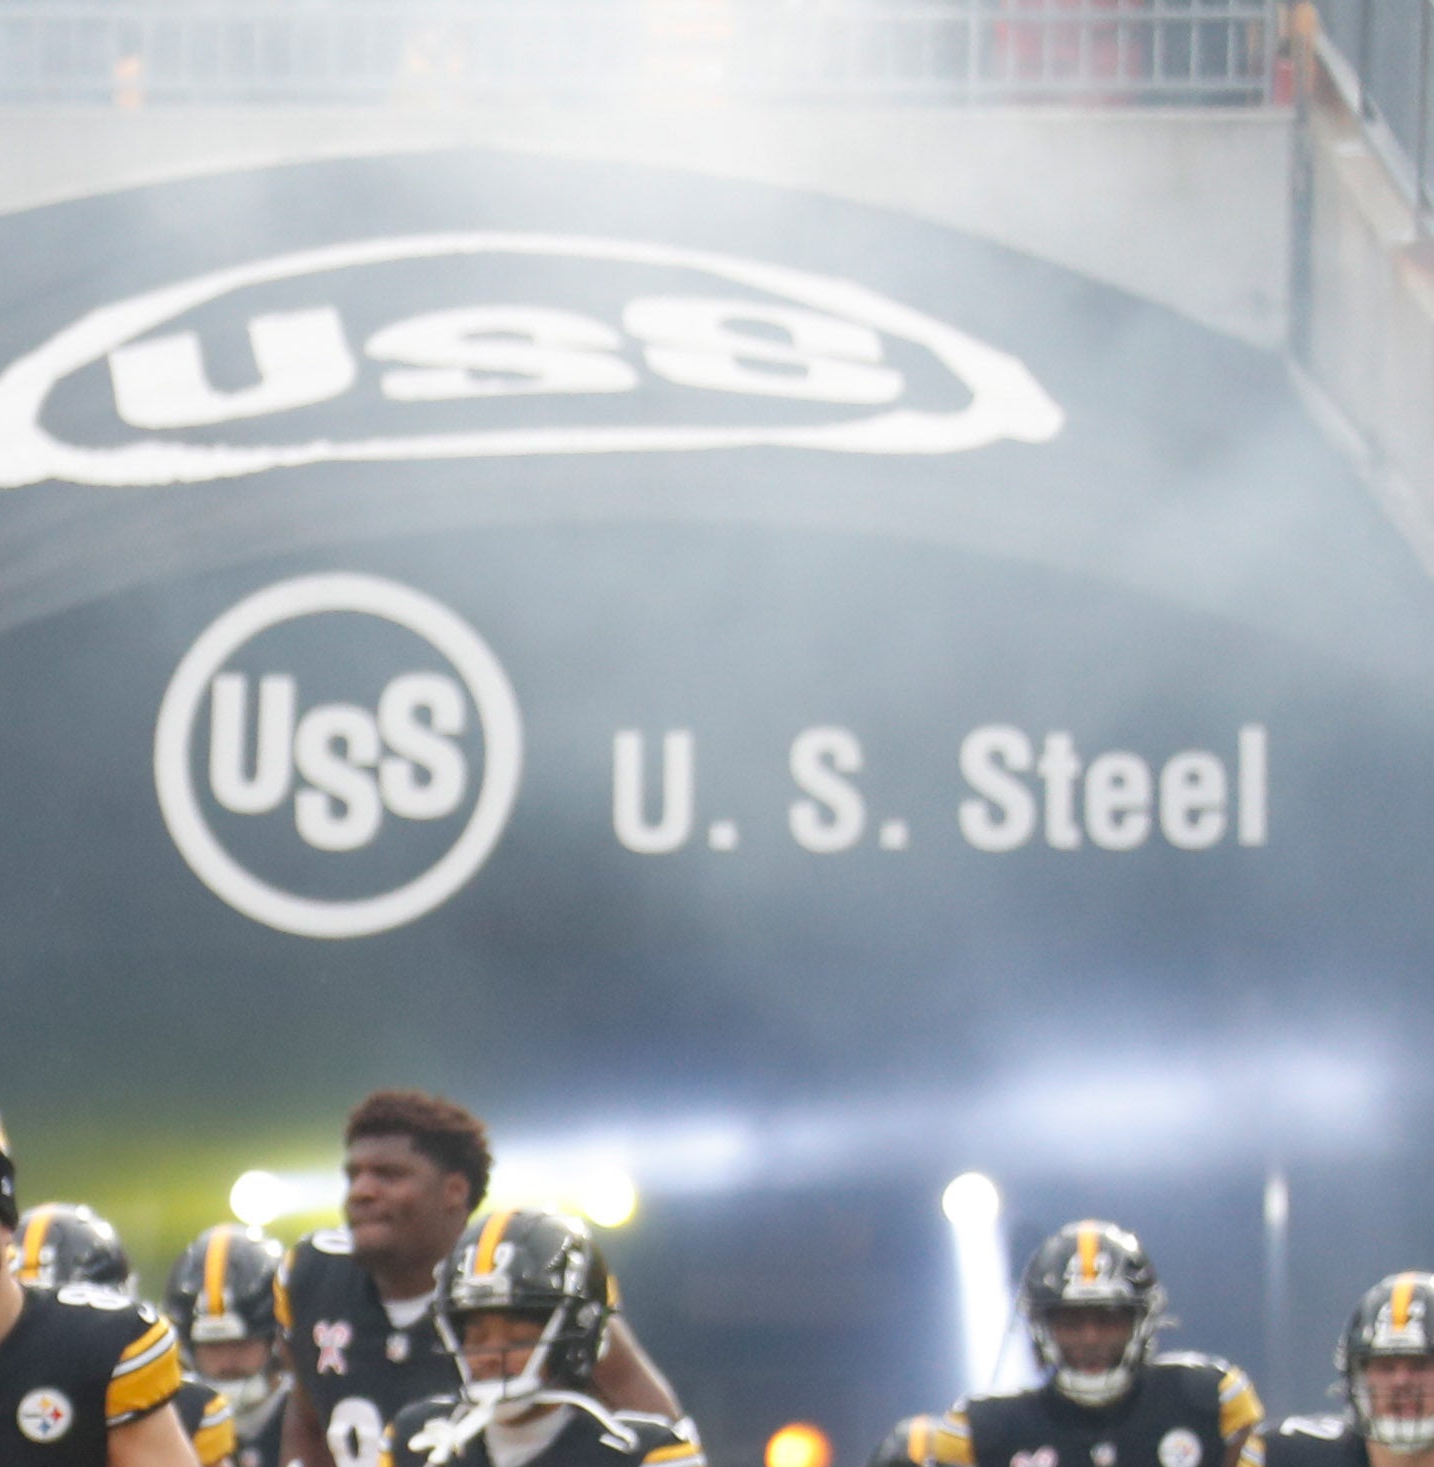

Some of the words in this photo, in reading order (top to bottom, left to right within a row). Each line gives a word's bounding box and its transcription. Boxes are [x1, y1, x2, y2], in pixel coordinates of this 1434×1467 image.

[211, 672, 466, 851] USS
[612, 726, 741, 852] U.
[788, 723, 910, 852] S.
[959, 722, 1268, 850] Steel
